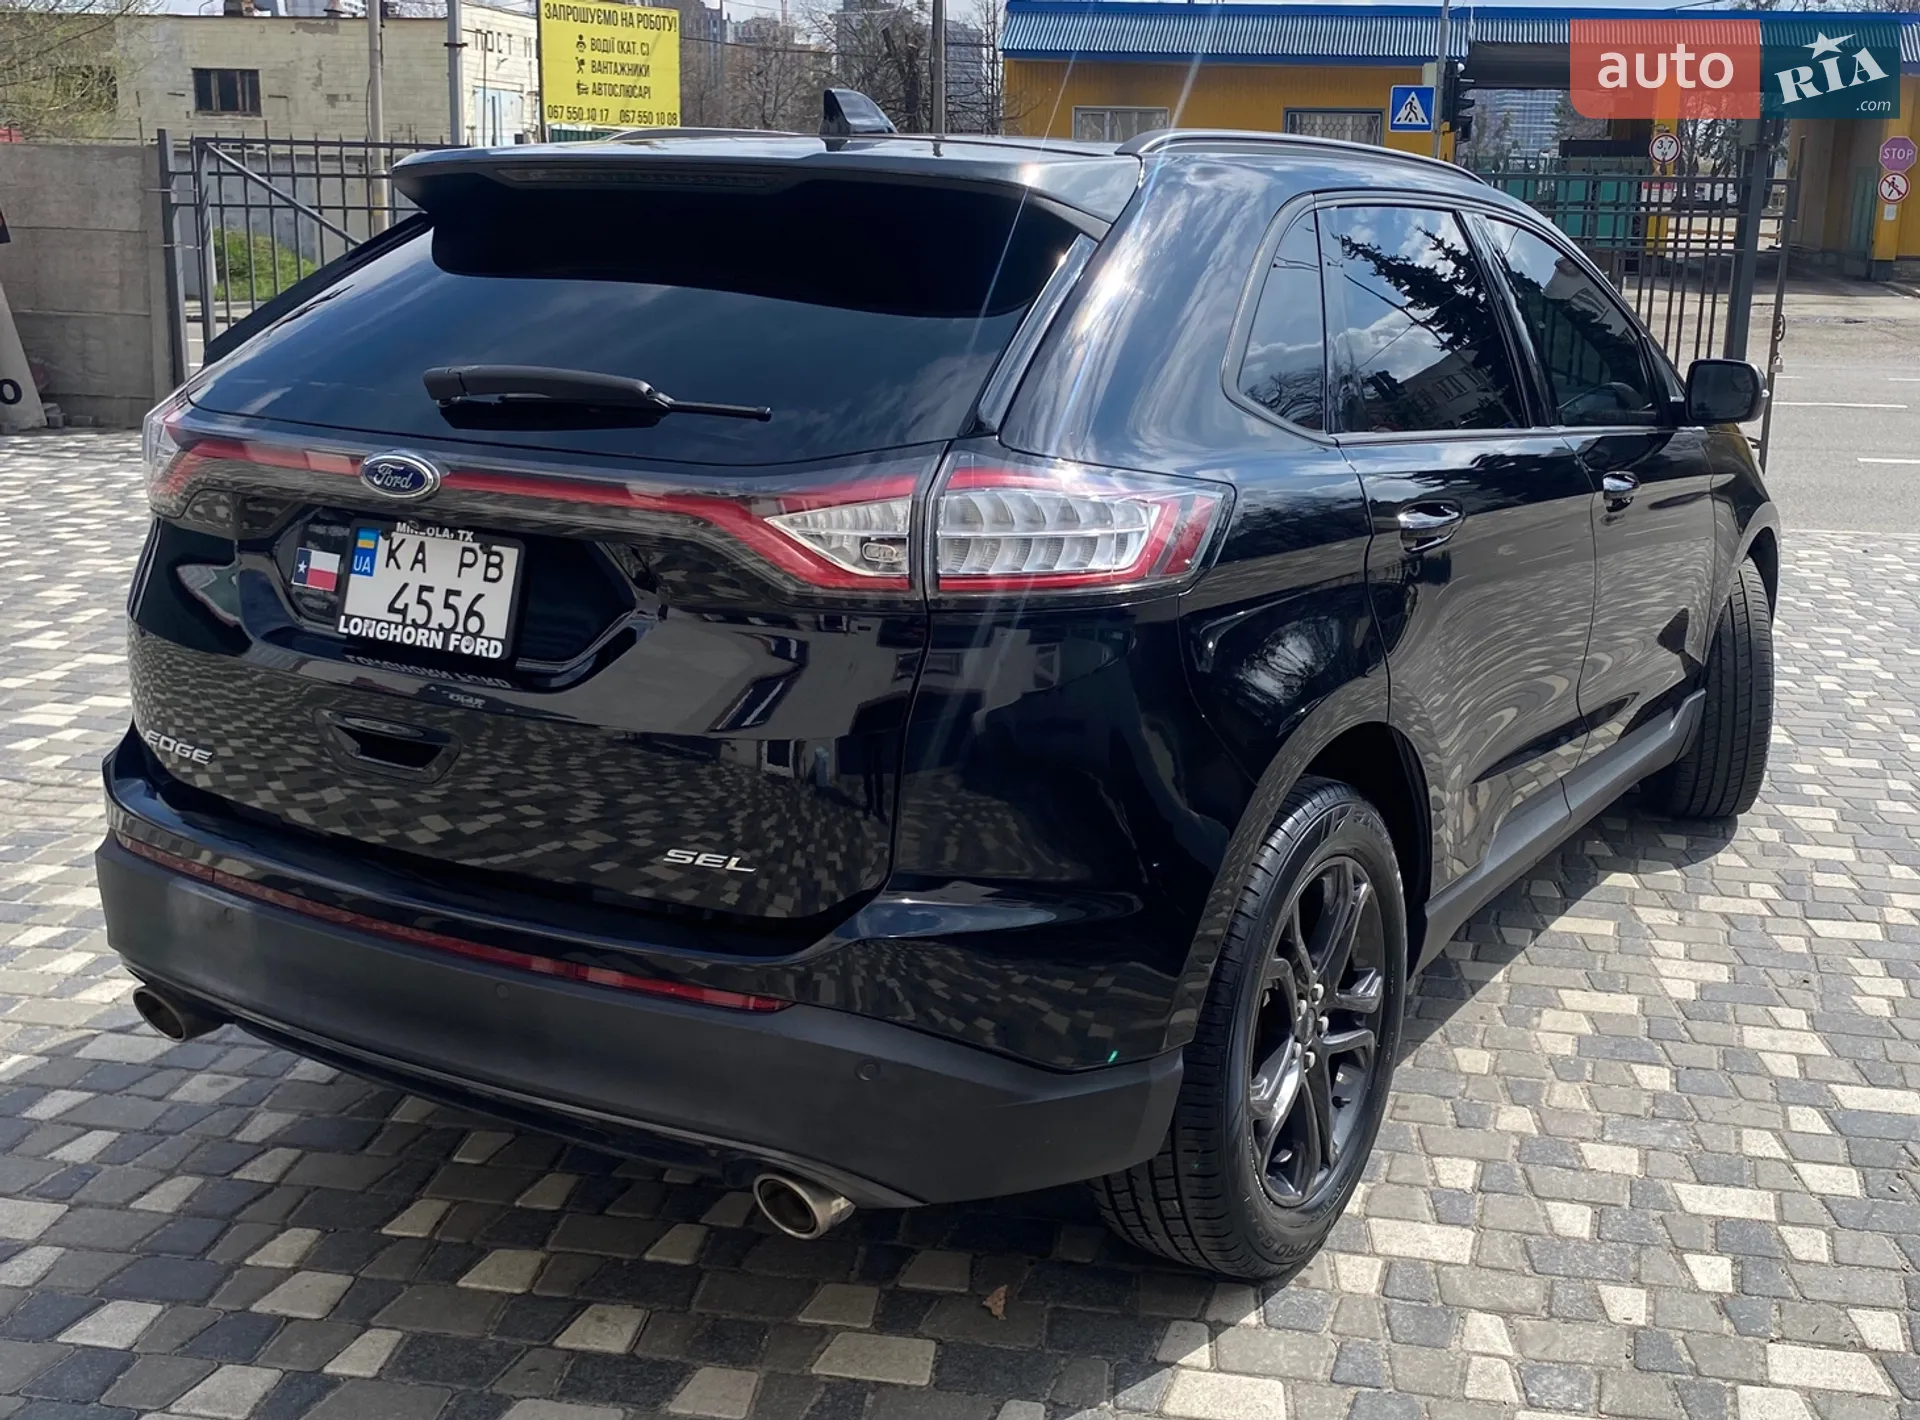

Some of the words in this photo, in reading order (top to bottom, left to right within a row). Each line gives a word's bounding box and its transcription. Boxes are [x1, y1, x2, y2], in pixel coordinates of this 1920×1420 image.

[544, 2, 618, 27] ЗАПРОШУЄМО
[620, 10, 635, 28] НА
[637, 13, 677, 32] РОБОТУ!
[590, 37, 616, 54] ВОДІЇ
[617, 40, 639, 56] (КАТ.
[591, 60, 650, 77] ВАНТАЖНИКИ
[591, 82, 652, 99] АВТОСЛЮСАРІ
[547, 105, 564, 119] 067
[567, 106, 584, 120] 550
[587, 108, 597, 121] 10
[600, 109, 609, 121] 17
[620, 109, 635, 123] 067
[637, 110, 654, 125] 550
[656, 112, 666, 126] 10
[1883, 148, 1914, 160] STOP
[373, 463, 414, 489] Ford
[396, 521, 455, 539] MIOLA,
[457, 529, 475, 542] TX
[353, 556, 372, 574] UA
[385, 538, 427, 573] KA
[457, 546, 504, 583] PB
[388, 582, 486, 634] 4556
[338, 615, 444, 649] LONGHORN
[448, 634, 504, 659] FORD
[145, 729, 213, 765] EDGE
[663, 848, 756, 872] SEL
